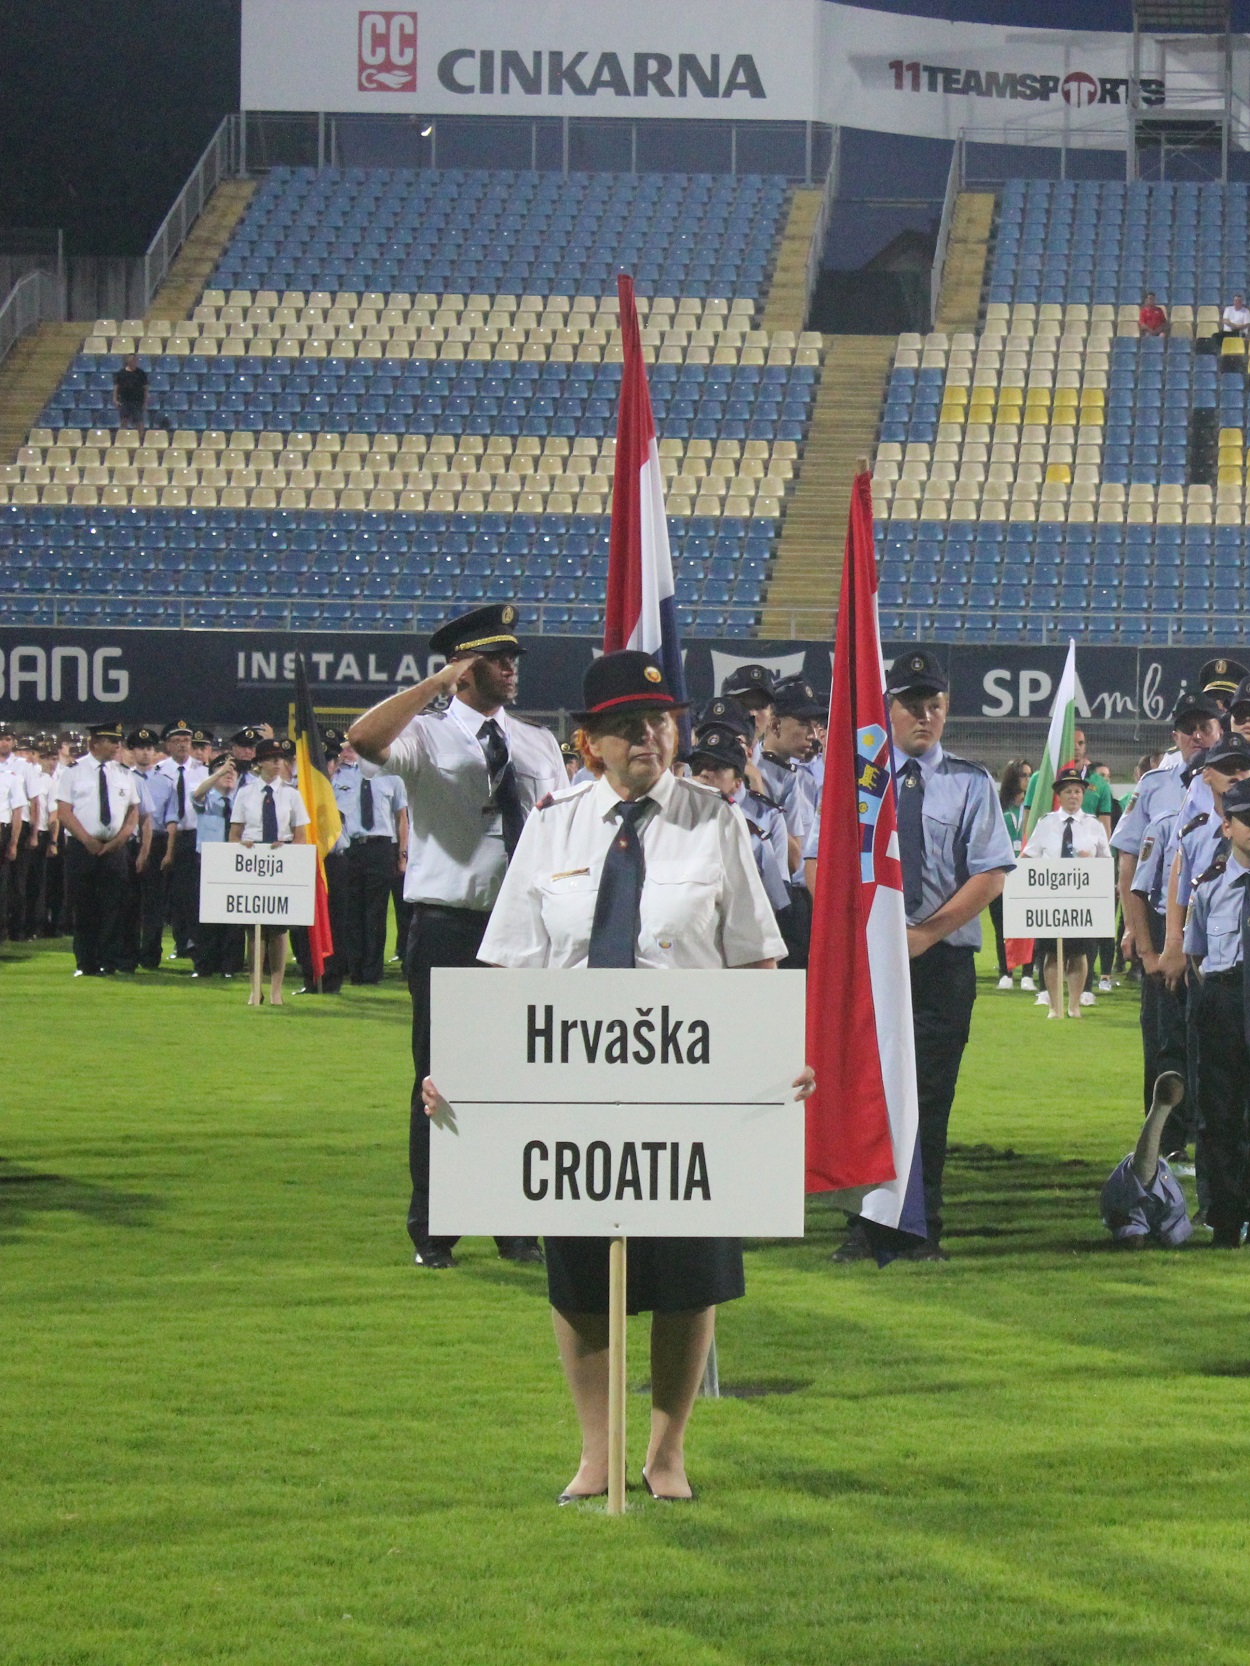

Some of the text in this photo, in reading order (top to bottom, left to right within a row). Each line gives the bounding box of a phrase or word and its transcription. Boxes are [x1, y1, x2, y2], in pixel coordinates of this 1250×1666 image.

[437, 48, 767, 99] CINKARNA
[0, 646, 130, 702] ANG
[235, 854, 283, 877] Belgija
[1028, 868, 1090, 890] Bolgarija
[226, 894, 288, 914] BELGIUM
[1026, 909, 1093, 927] BULGARIA
[526, 1004, 711, 1066] Hrvaška
[522, 1140, 712, 1202] CROATIA
